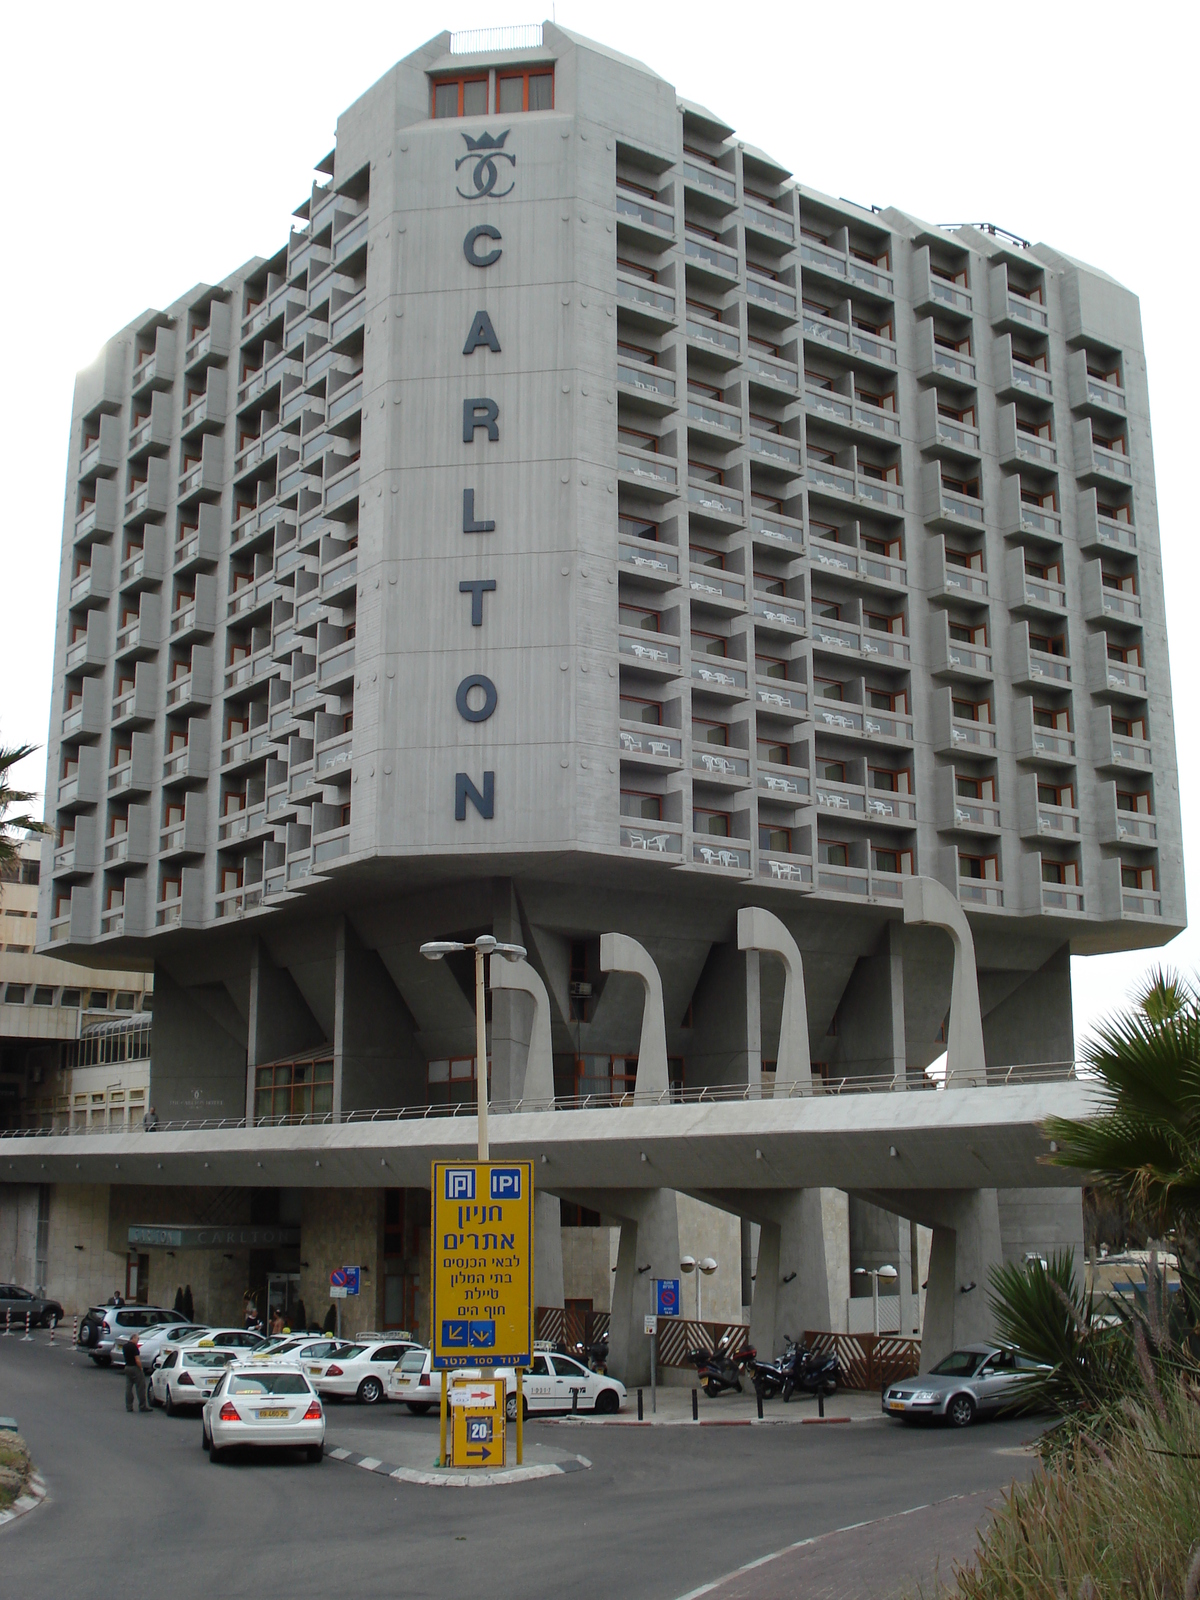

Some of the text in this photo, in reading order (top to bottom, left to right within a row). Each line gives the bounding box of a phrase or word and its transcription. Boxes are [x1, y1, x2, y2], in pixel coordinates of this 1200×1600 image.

[455, 224, 503, 821] CARLTON
[457, 1205, 503, 1229] חניון
[197, 1230, 288, 1244] CARLTON
[443, 1233, 515, 1250] אתרים
[443, 1254, 520, 1269] לבאי הכנסים
[451, 1270, 512, 1288] בתי המלון
[464, 1286, 500, 1300] טיילת
[457, 1305, 506, 1320] חוף הים
[442, 1357, 467, 1365] מטר
[500, 1356, 520, 1364] עוד
[471, 1423, 487, 1439] 20
